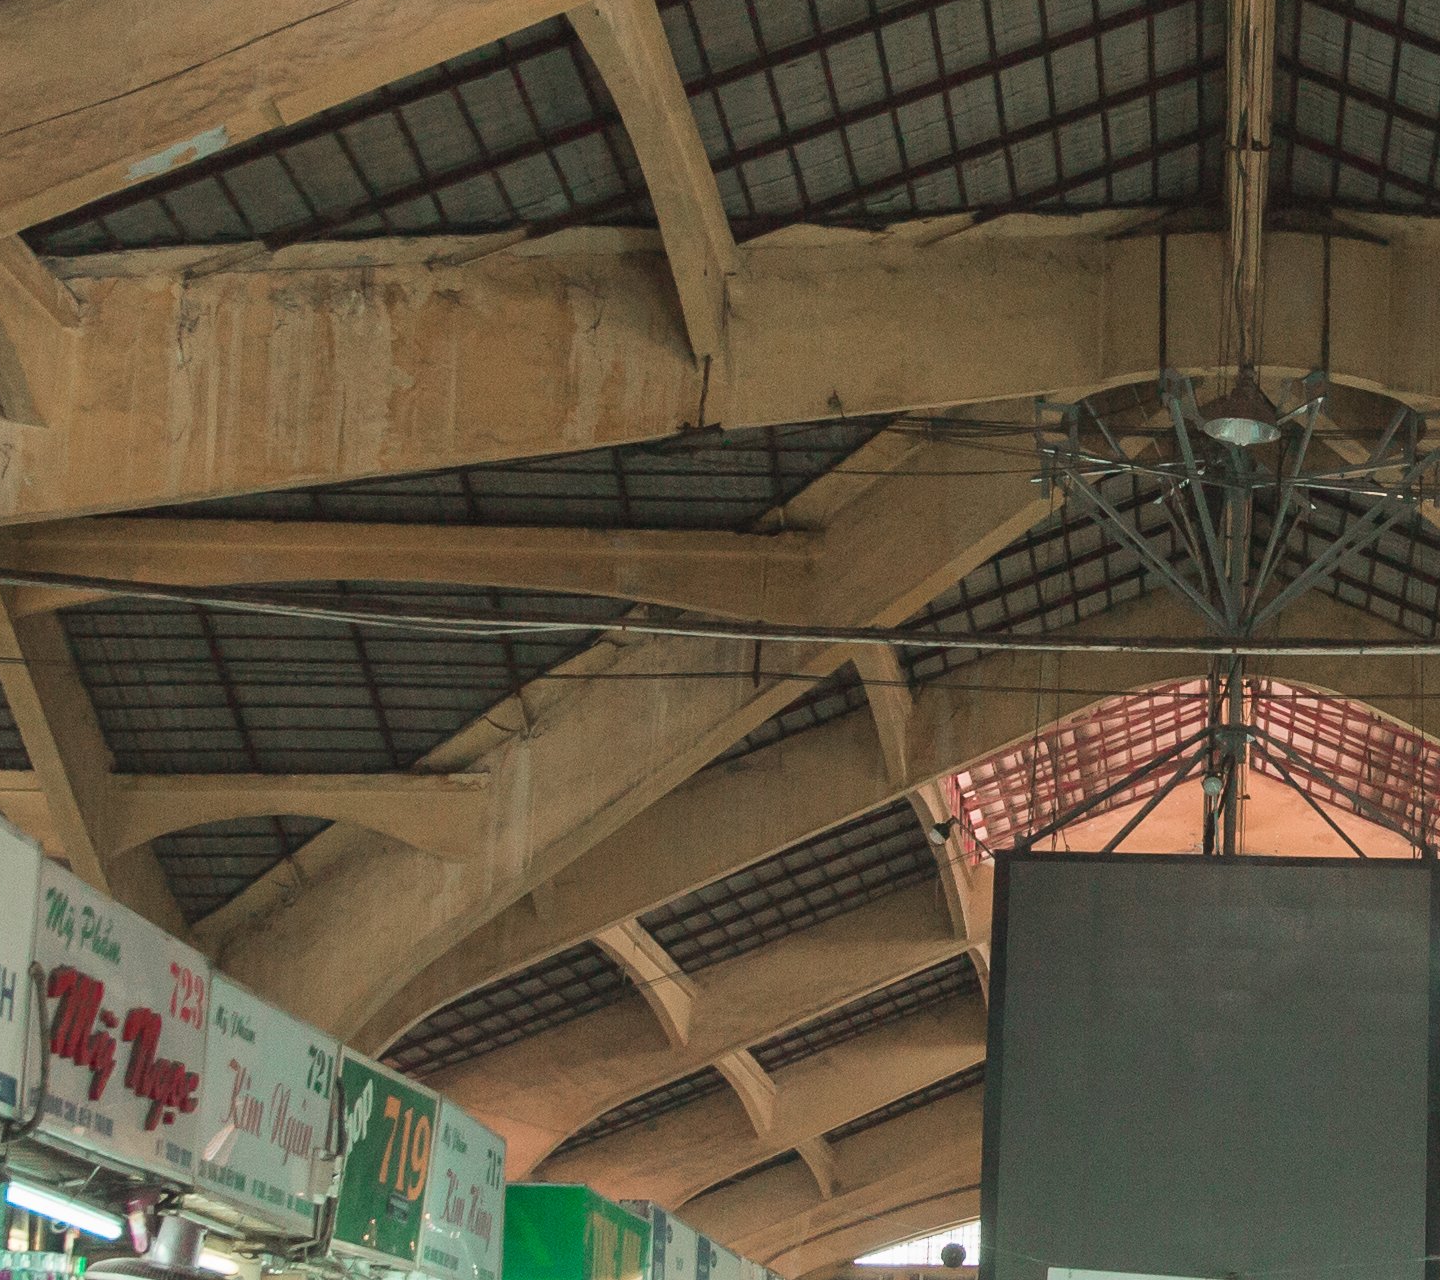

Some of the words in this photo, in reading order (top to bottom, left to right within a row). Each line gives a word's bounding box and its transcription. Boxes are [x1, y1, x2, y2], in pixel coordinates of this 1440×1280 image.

[170, 960, 205, 1032] 723
[307, 1043, 334, 1102] 721
[380, 1094, 432, 1202] 719
